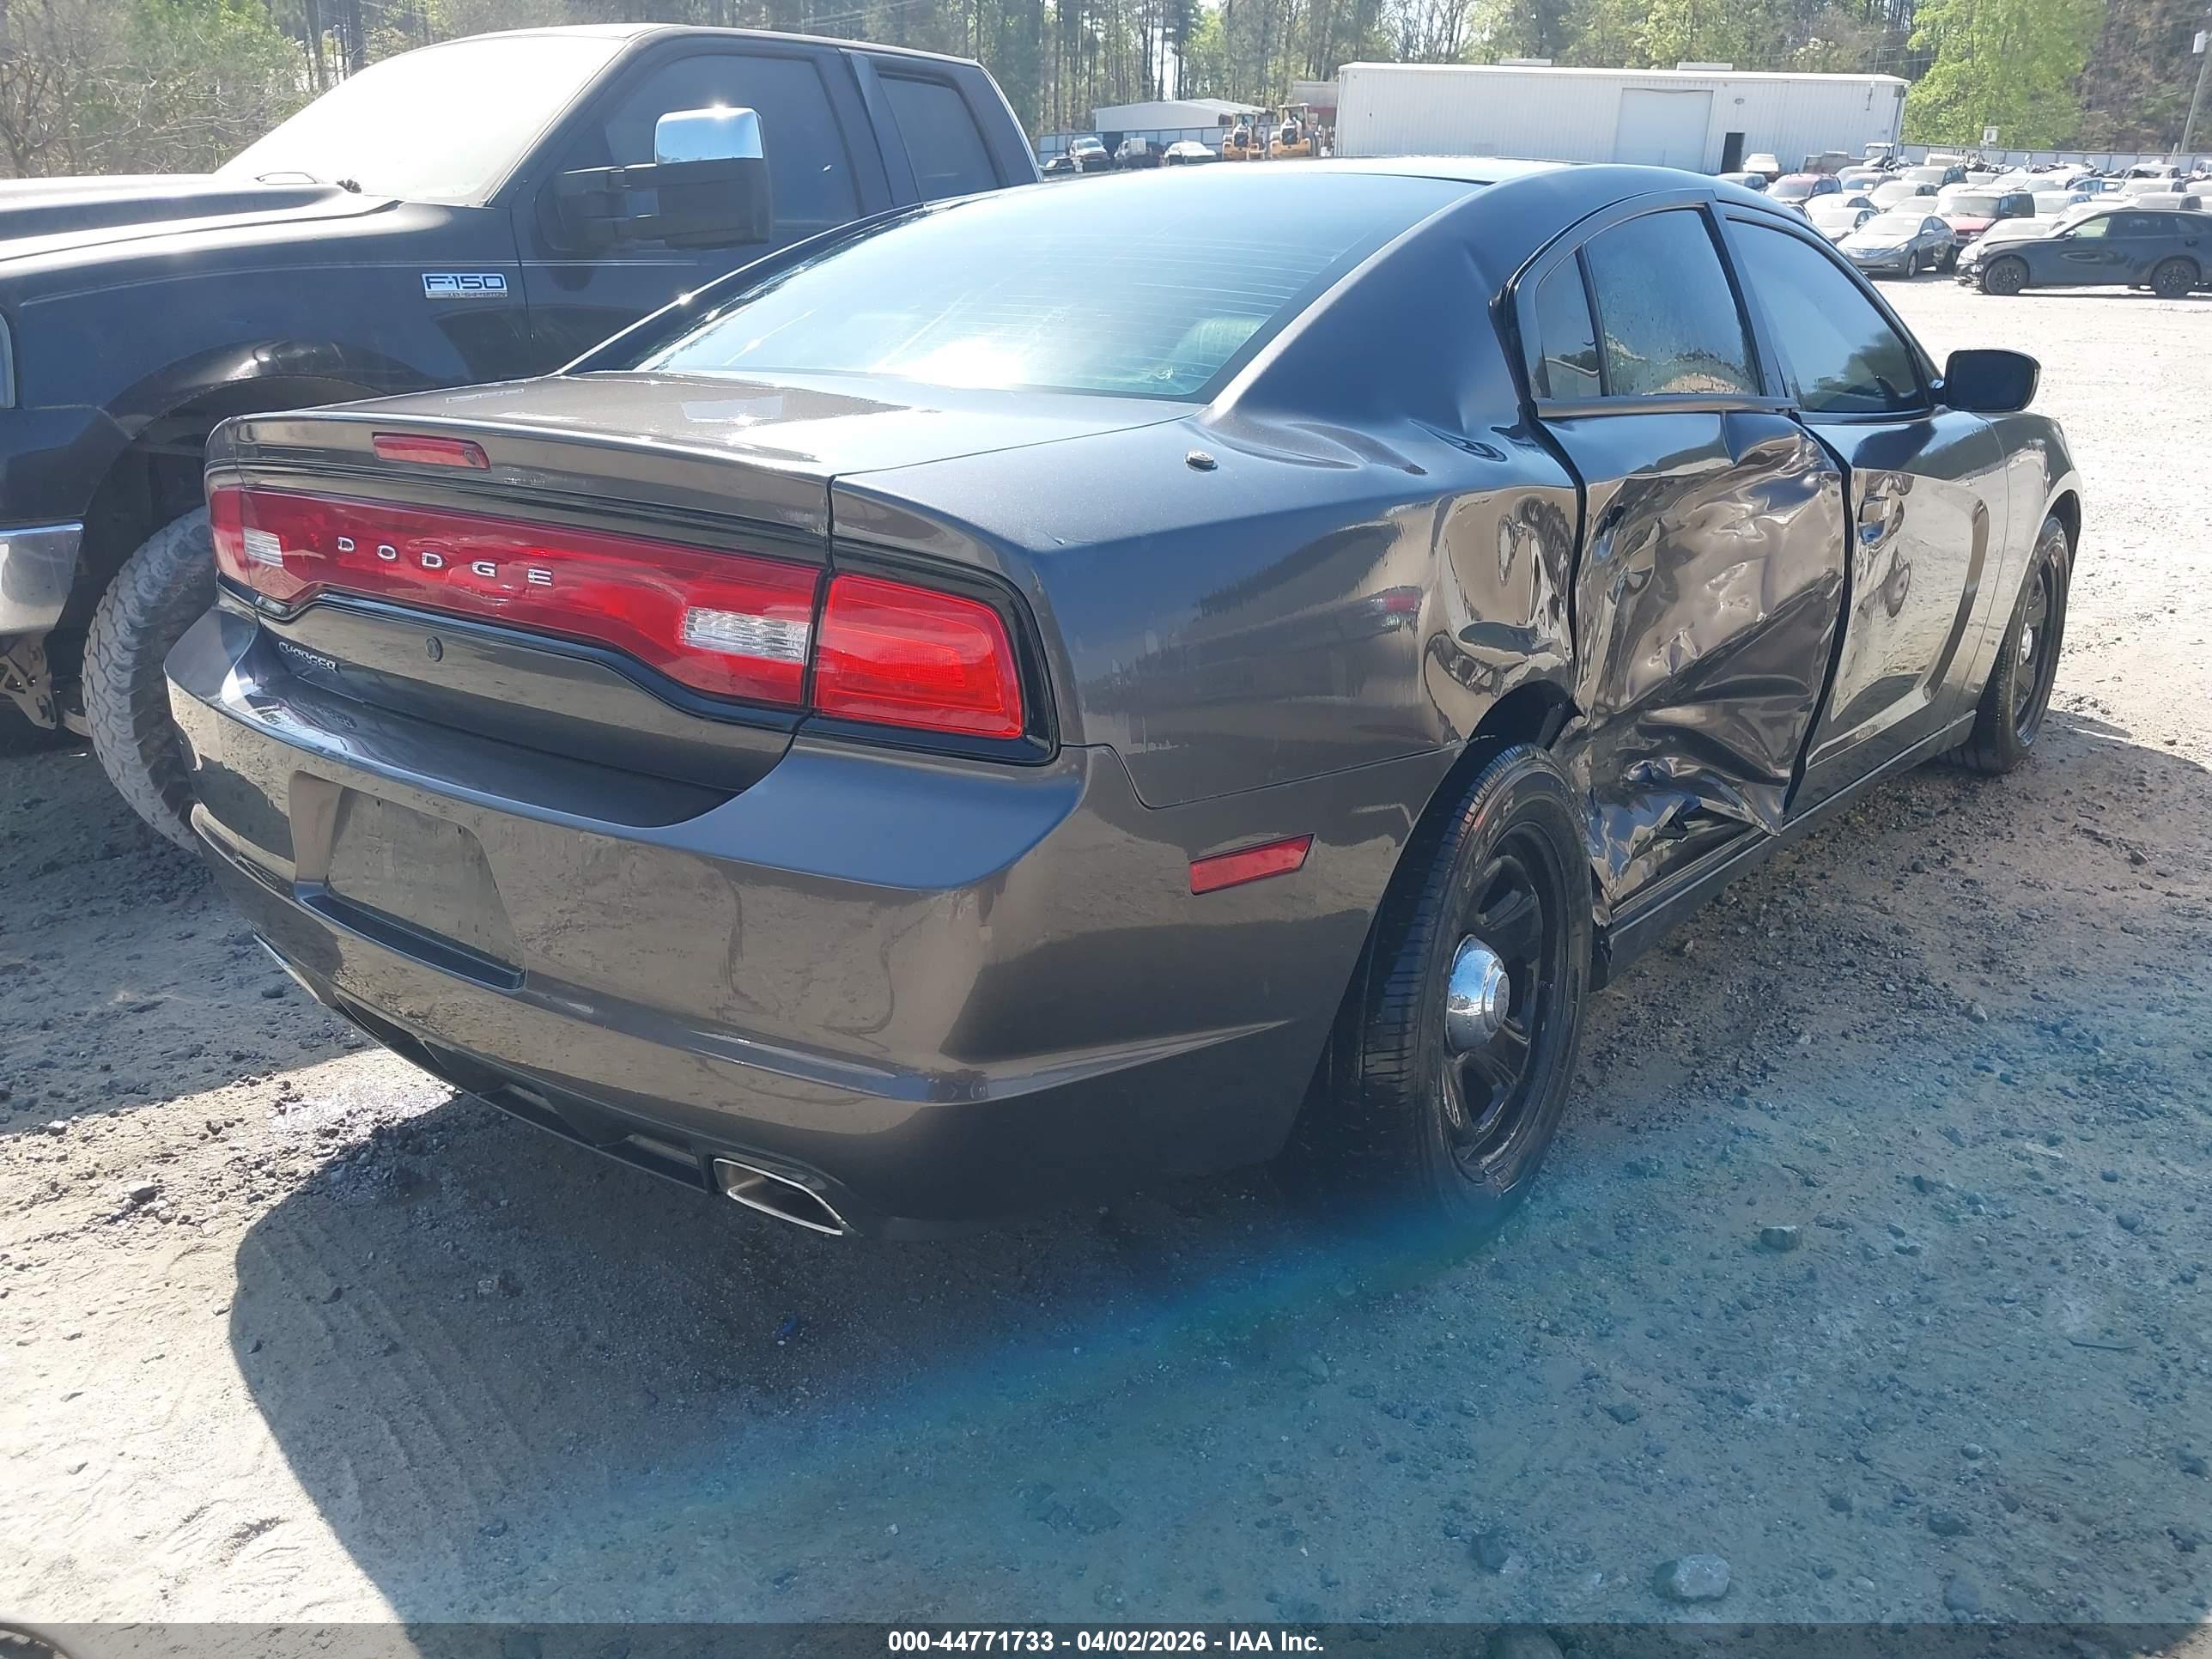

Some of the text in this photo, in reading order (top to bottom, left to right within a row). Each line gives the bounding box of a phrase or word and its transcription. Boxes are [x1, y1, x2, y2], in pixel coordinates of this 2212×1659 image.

[424, 275, 506, 290] F-150
[337, 536, 553, 586] DODGE
[278, 641, 338, 674] CHARGER
